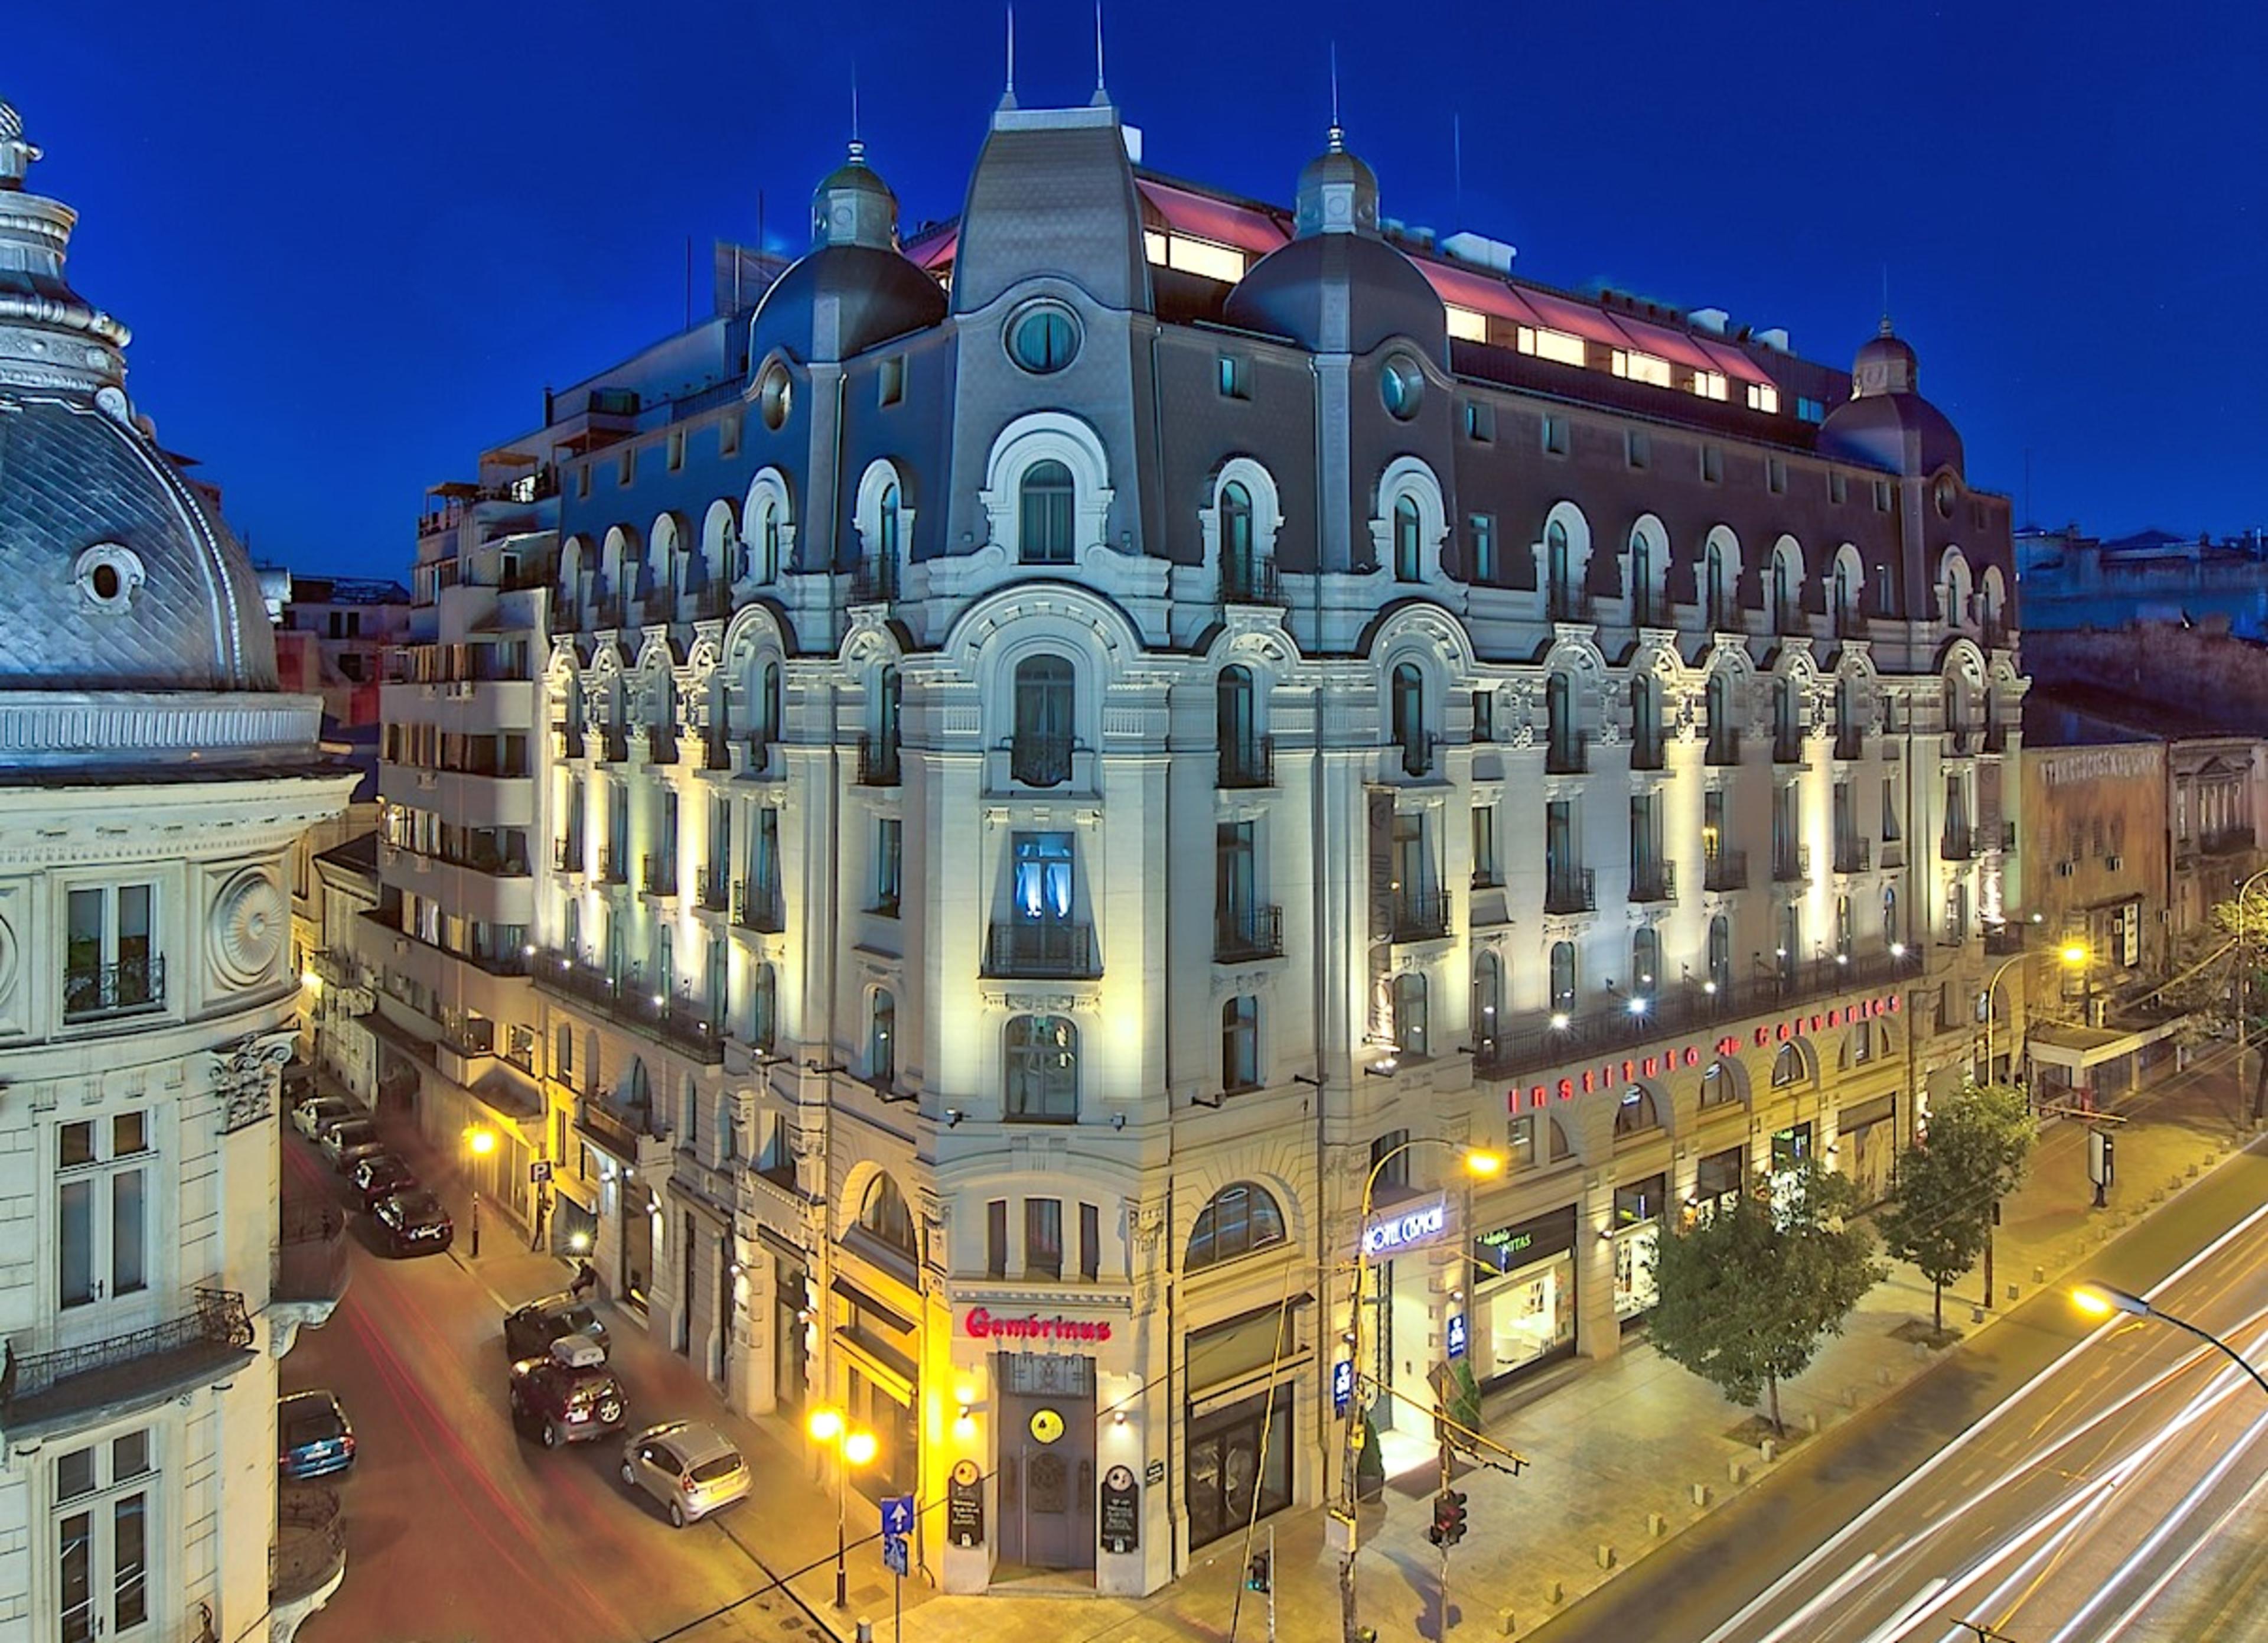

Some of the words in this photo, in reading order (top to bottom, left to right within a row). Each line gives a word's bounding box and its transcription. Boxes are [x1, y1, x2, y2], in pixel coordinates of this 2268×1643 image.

[1509, 1046, 1700, 1114] Instituto
[1755, 994, 1901, 1048] Cervantes
[534, 1164, 548, 1180] P
[965, 1306, 1112, 1342] Gambrinus
